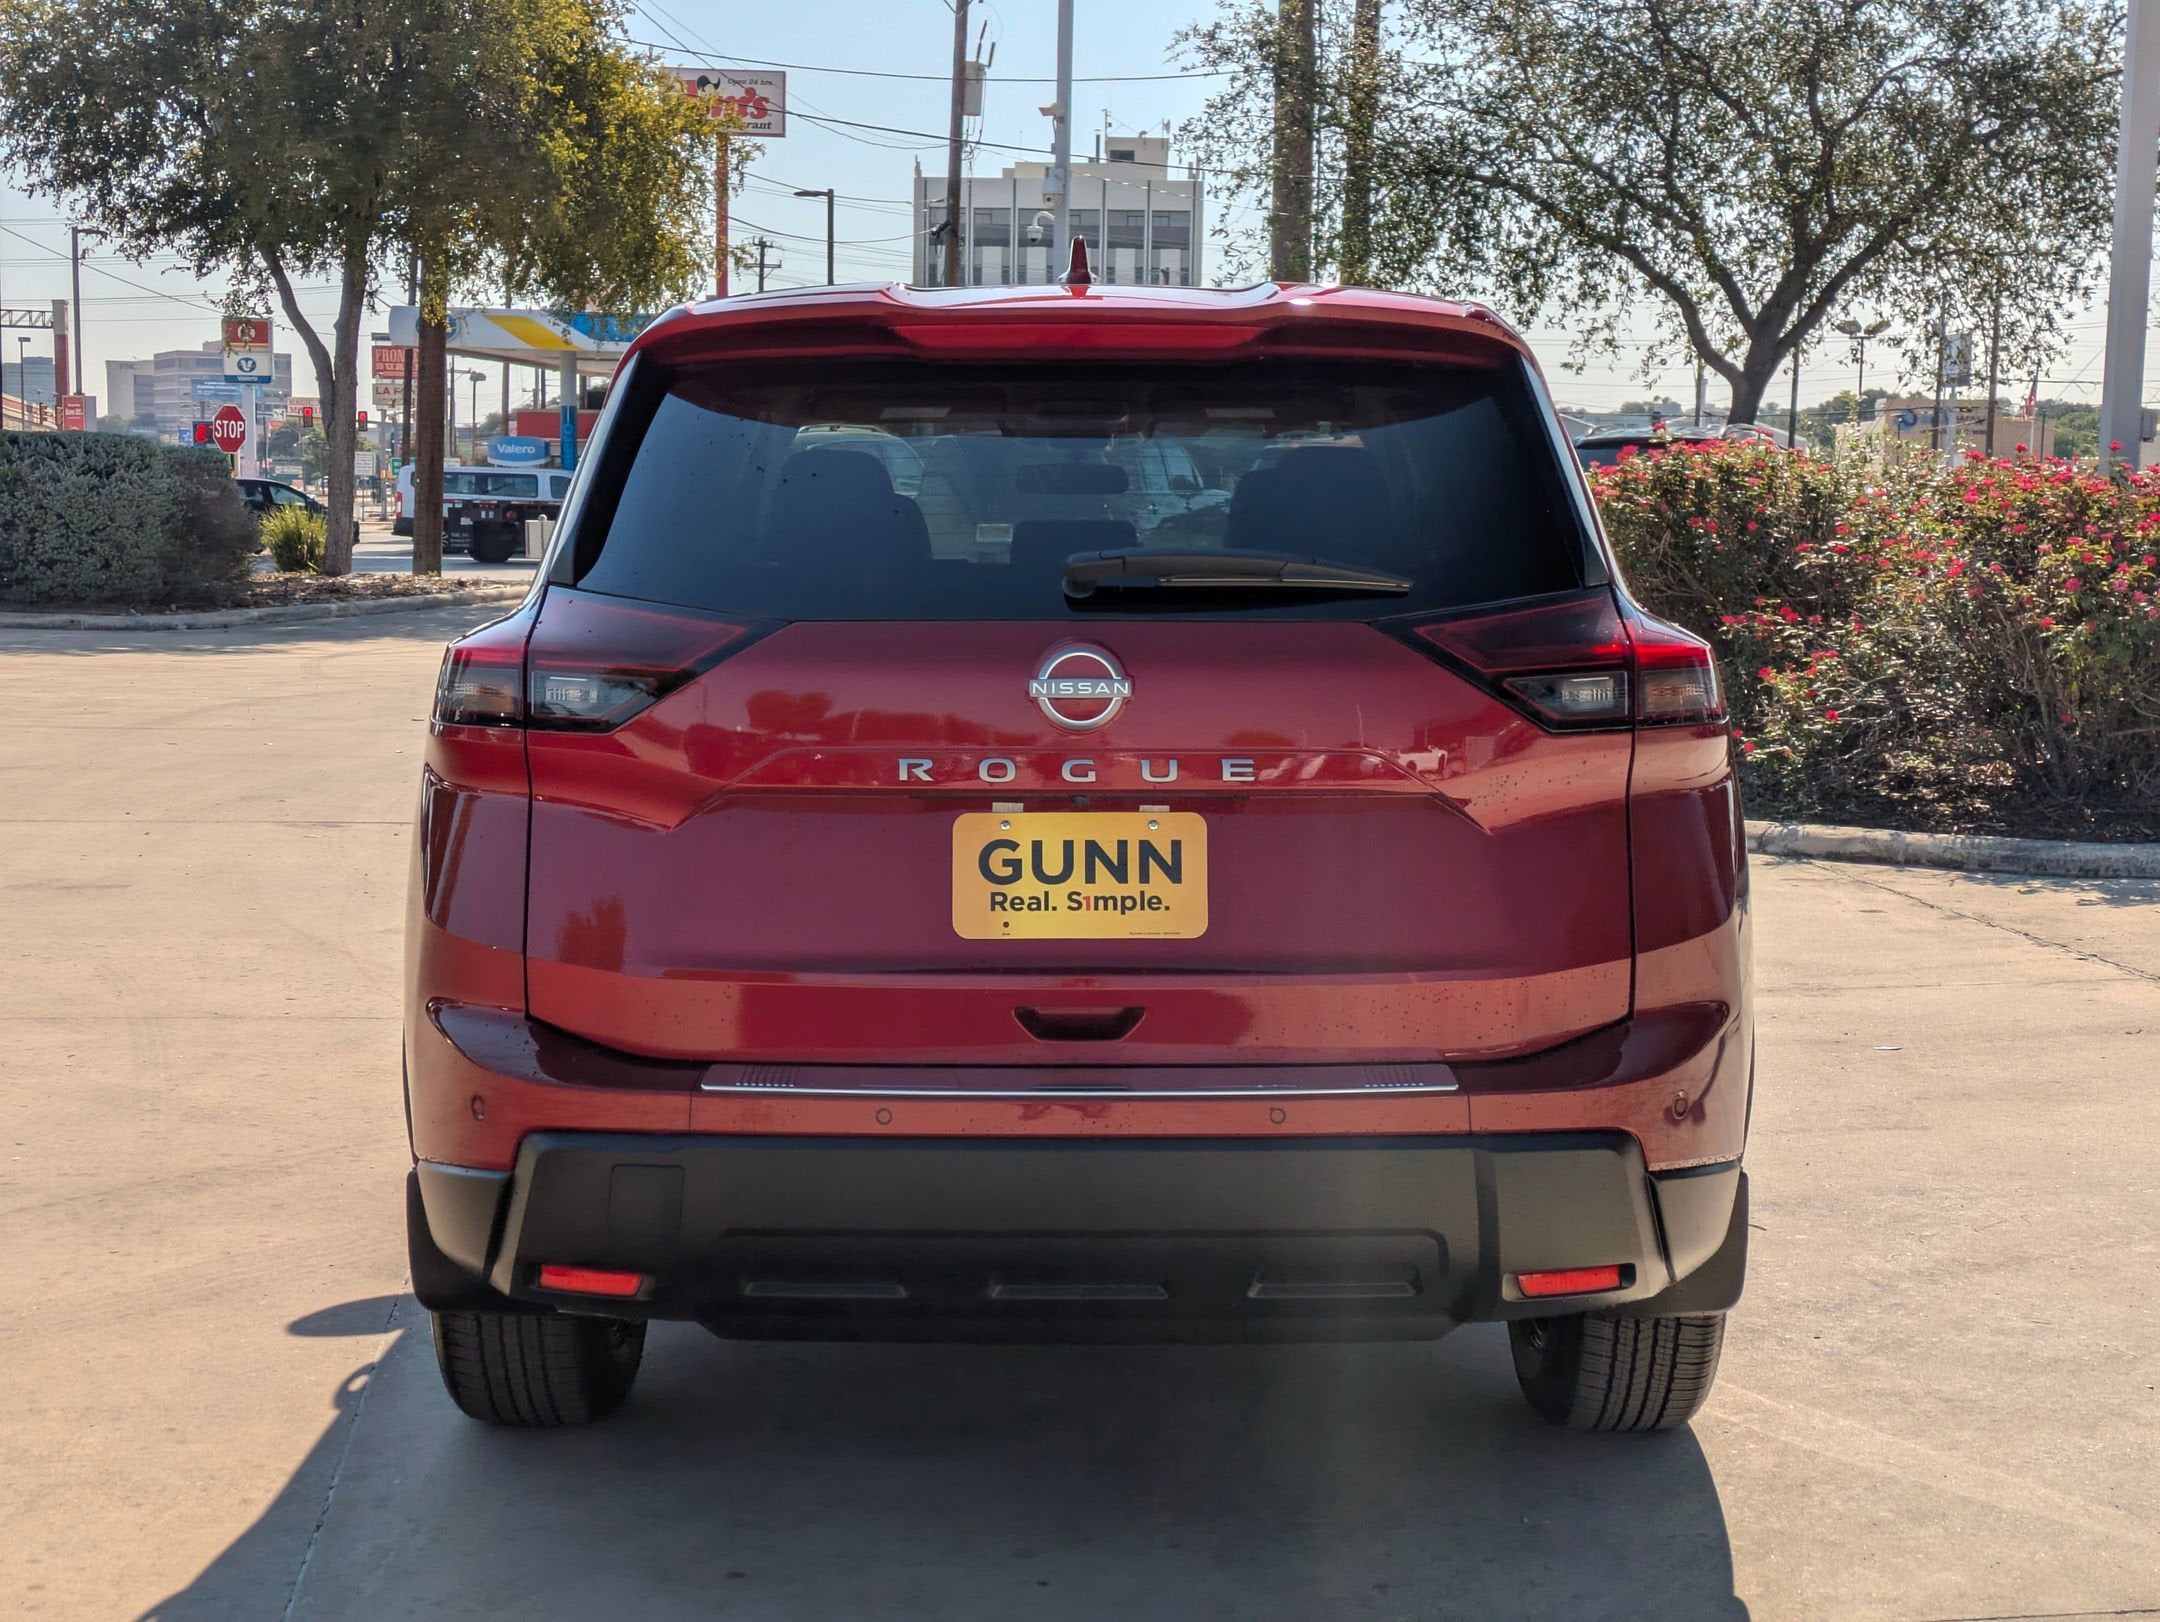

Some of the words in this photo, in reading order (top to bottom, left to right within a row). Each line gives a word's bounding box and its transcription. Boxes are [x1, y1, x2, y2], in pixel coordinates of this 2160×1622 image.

[215, 420, 245, 438] STOP
[497, 443, 536, 454] Valero
[1032, 680, 1130, 695] NISSAN
[898, 757, 1256, 783] ROGUE
[978, 838, 1183, 886] GUNN
[989, 890, 1058, 913] Real.
